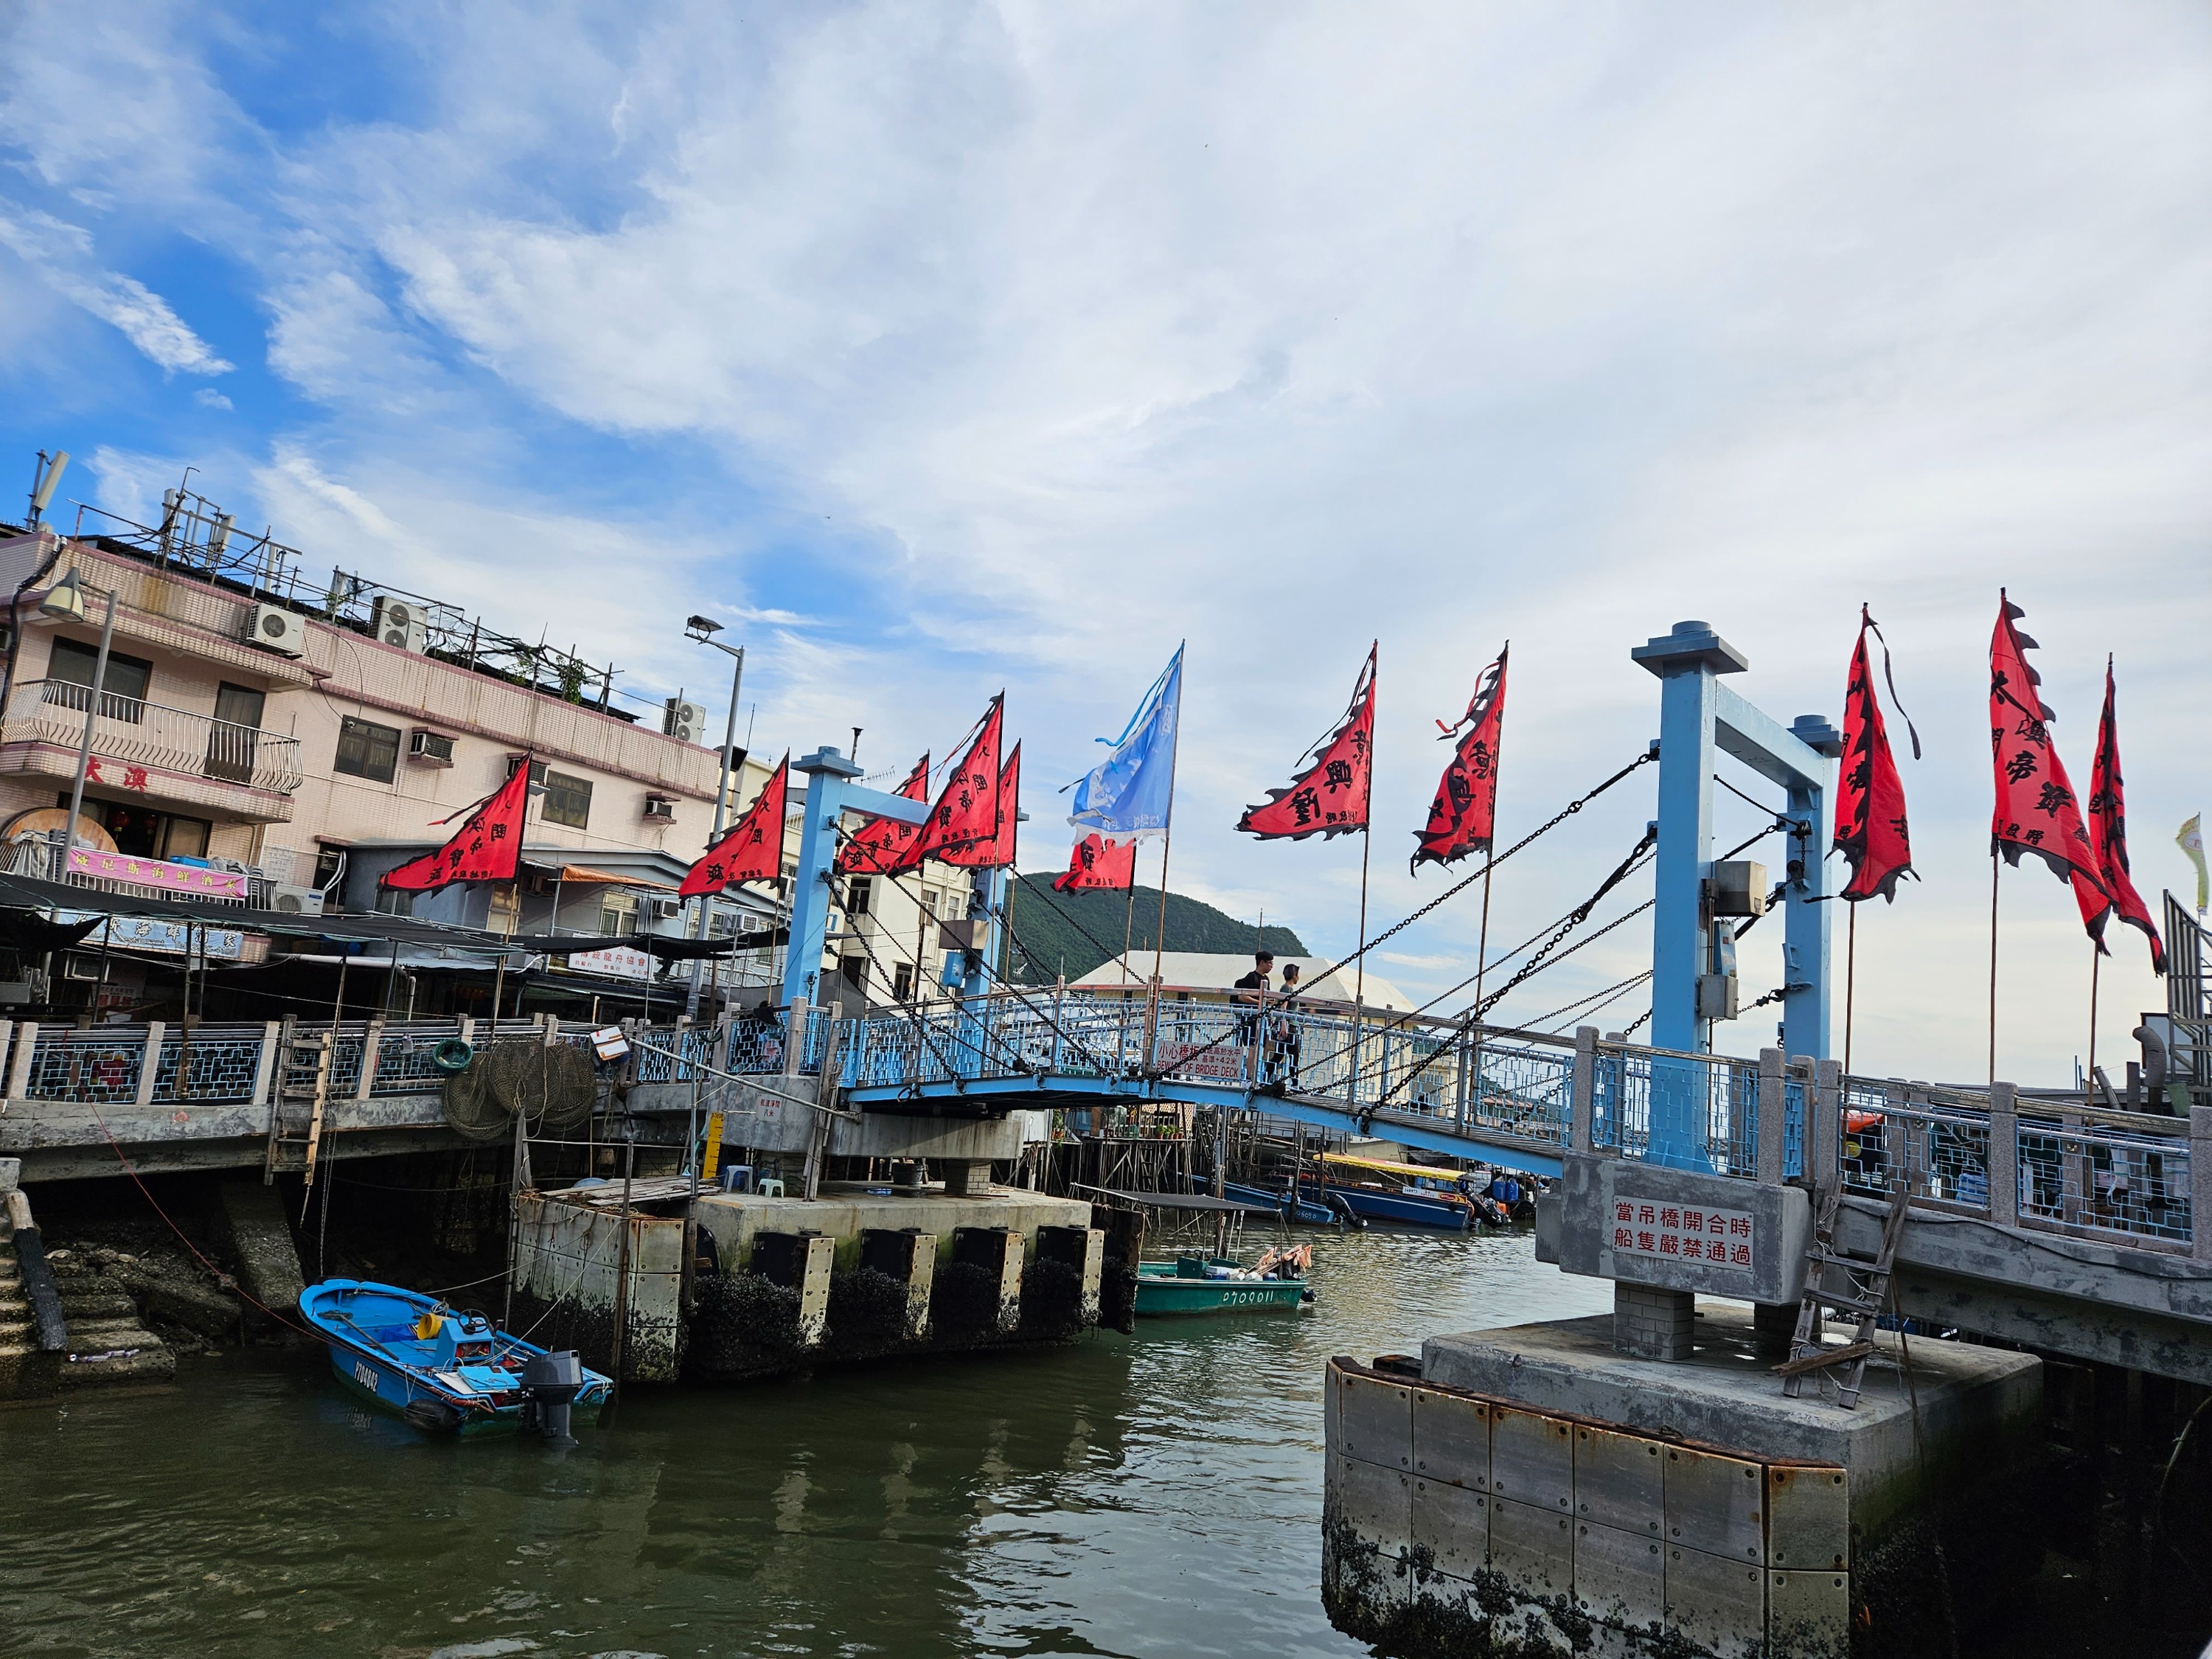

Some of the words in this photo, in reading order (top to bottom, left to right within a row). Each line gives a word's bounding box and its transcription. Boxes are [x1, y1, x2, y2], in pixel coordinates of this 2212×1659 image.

[86, 755, 147, 793] 大澳
[76, 855, 236, 889] 威尼斯海鮮酒家
[1158, 1042, 1200, 1062] 小心橋板
[1203, 1046, 1241, 1057] 底高於水平
[1184, 1062, 1194, 1073] OF
[1195, 1063, 1218, 1076] BRIDGE
[1220, 1065, 1239, 1078] DECK
[1615, 1202, 1752, 1238] 當吊橋開合時
[1614, 1227, 1751, 1266] 船隻嚴禁通過
